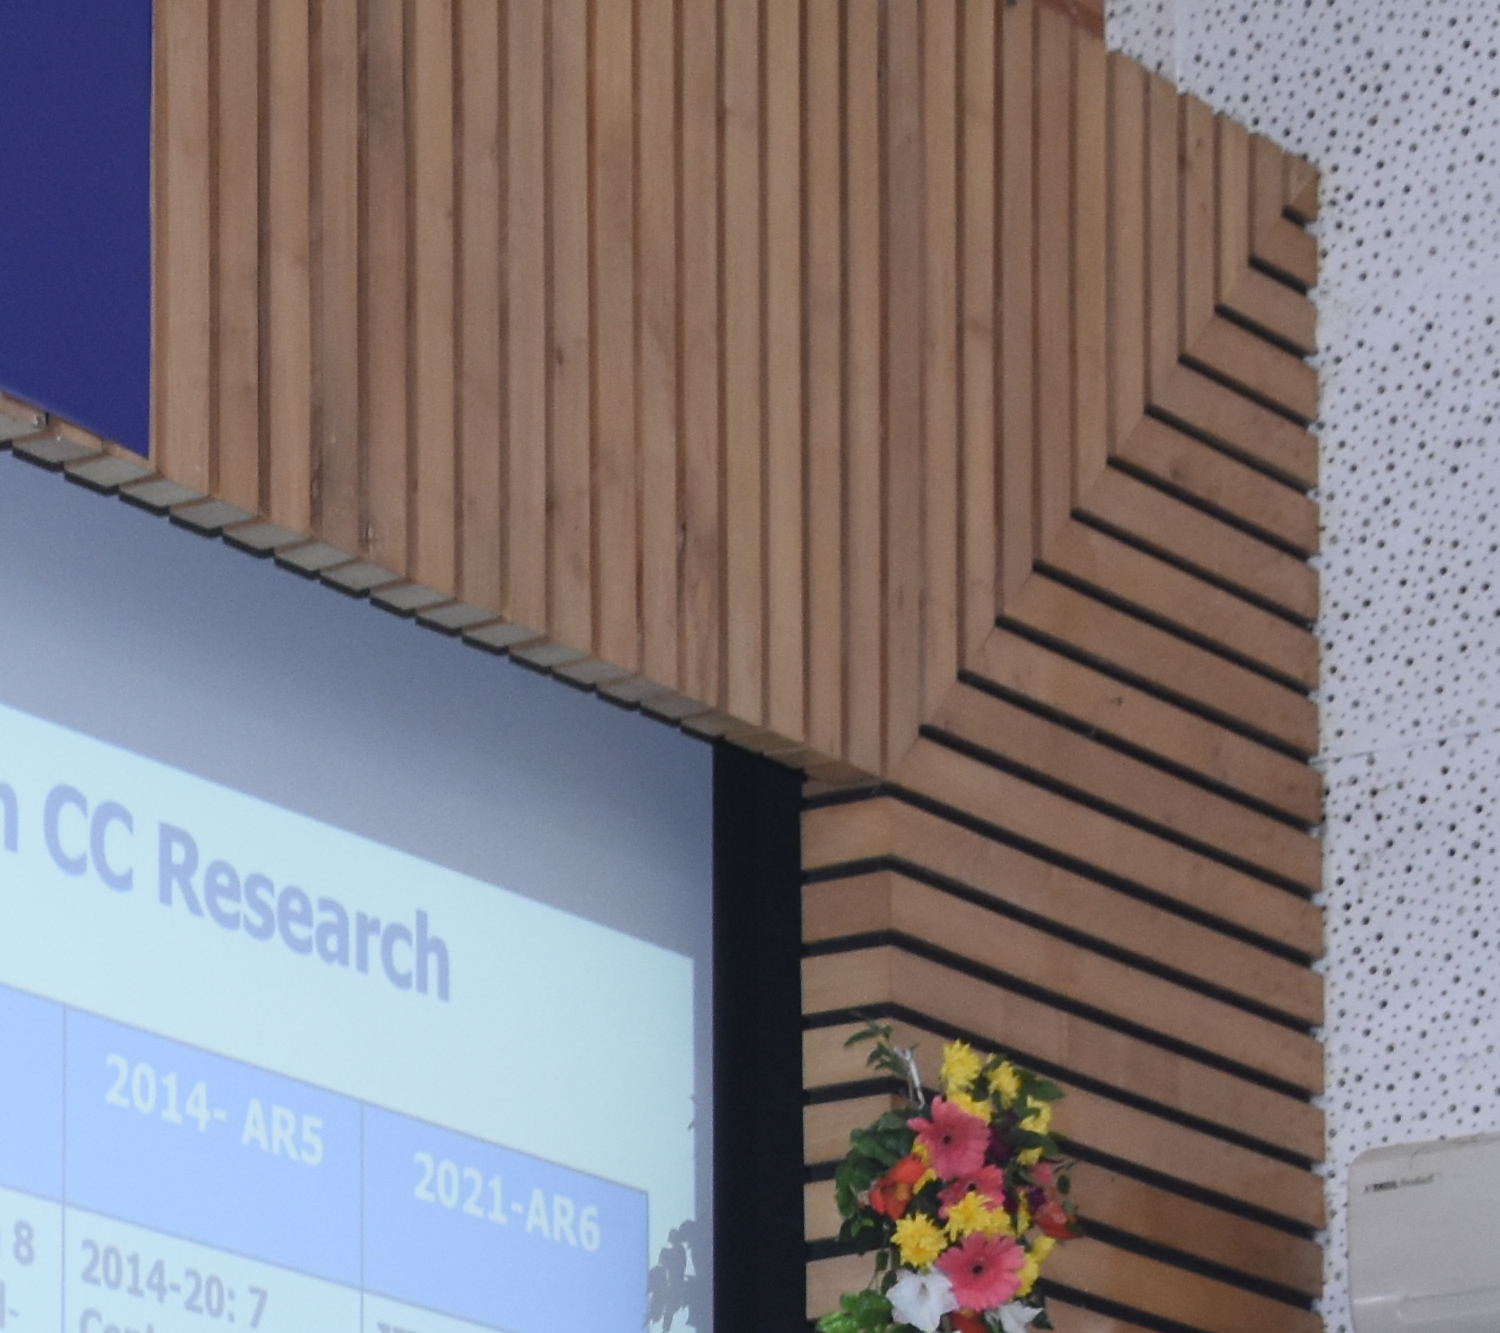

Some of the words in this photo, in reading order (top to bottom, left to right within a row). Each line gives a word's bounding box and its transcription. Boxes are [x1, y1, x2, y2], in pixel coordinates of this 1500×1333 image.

[43, 783, 134, 892] CC
[158, 821, 451, 1002] Research
[105, 1053, 227, 1132] 2014-
[241, 1098, 324, 1166] AR5
[411, 1149, 599, 1251] 2021-AR6
